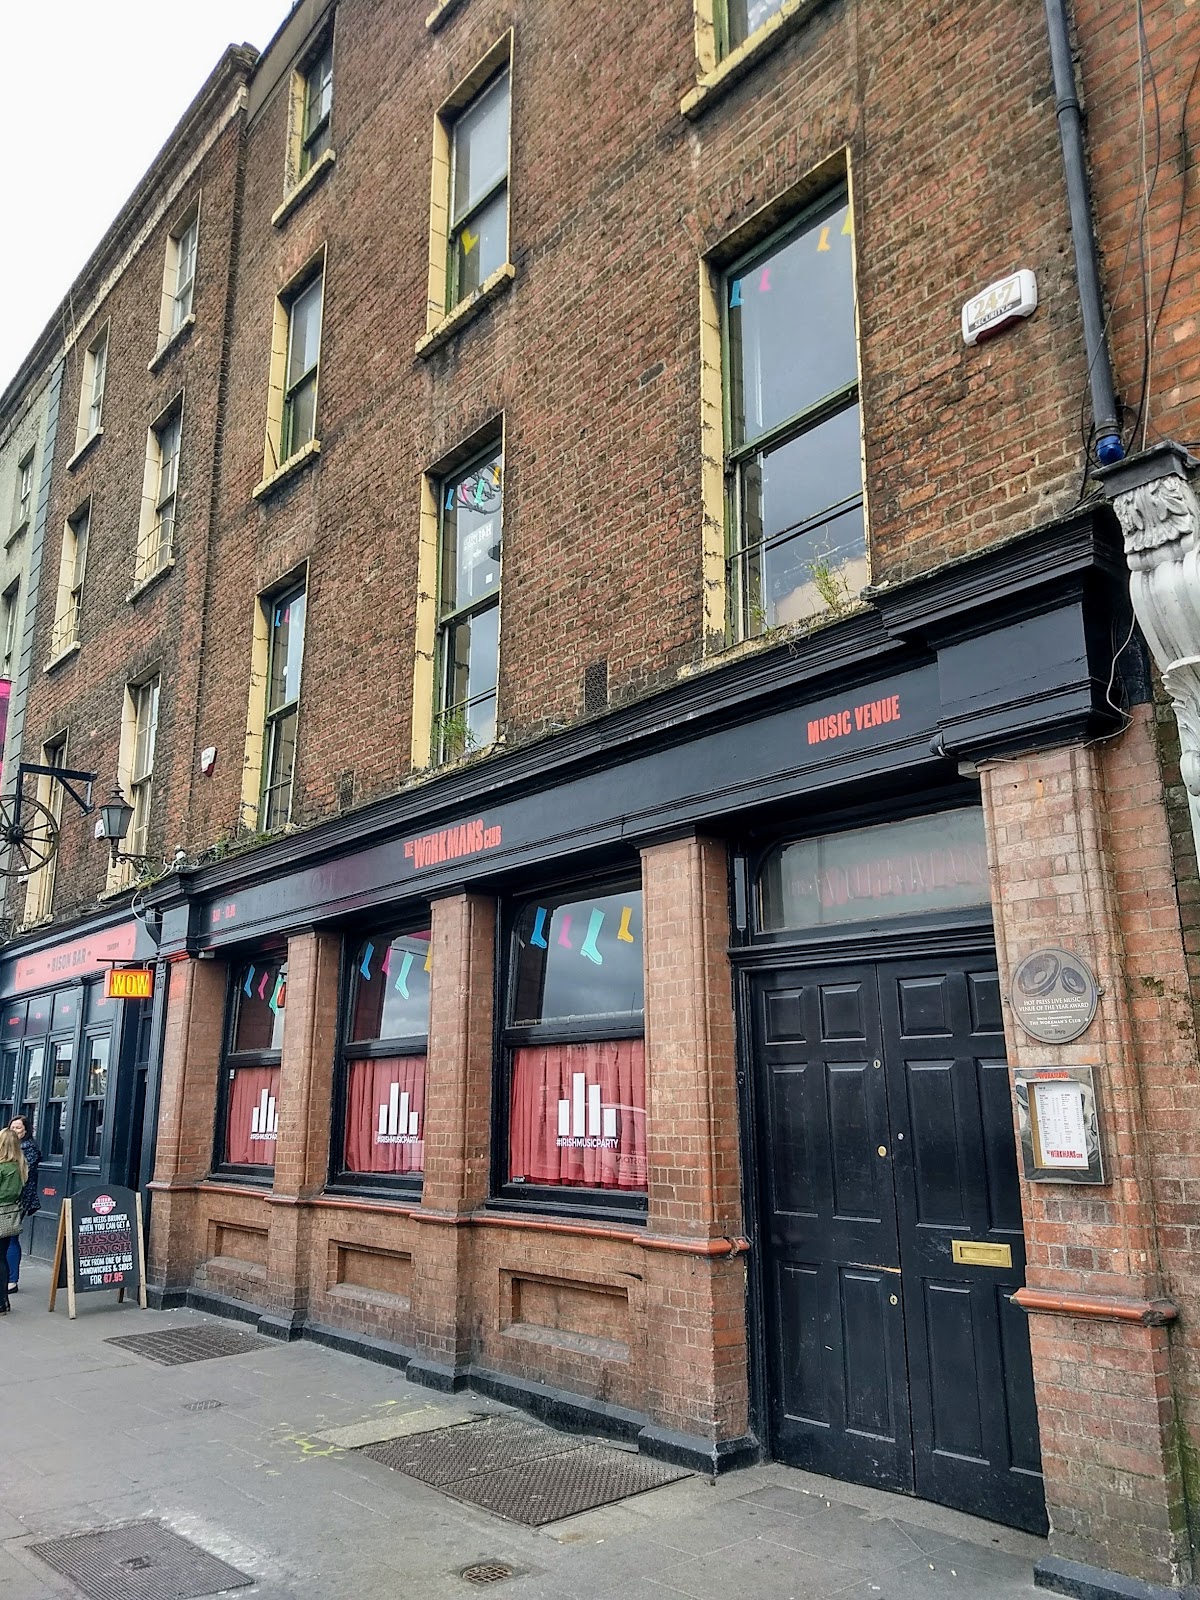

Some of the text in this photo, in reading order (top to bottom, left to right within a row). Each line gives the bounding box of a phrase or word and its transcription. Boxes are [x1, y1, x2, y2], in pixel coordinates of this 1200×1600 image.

[974, 281, 1015, 320] 24-7
[807, 695, 901, 745] MUSIC VENUE
[414, 818, 484, 869] WORKMANS
[483, 825, 502, 850] CLUB
[51, 948, 87, 972] BISON BAR
[113, 974, 149, 995] WOW
[556, 1137, 619, 1149] #IRISHMUSICPARTY
[79, 1220, 131, 1233] WHEN YOU CAN GET A
[81, 1213, 128, 1225] WHO NEEDS BRUNCH
[78, 1231, 131, 1246] BISON
[78, 1241, 132, 1257] LUNCH
[79, 1255, 133, 1268] PICK FROM ONE OF OUR
[79, 1265, 112, 1276] SANDWICHES
[118, 1262, 133, 1271] SIDES
[90, 1272, 124, 1285] FOR €7.95
